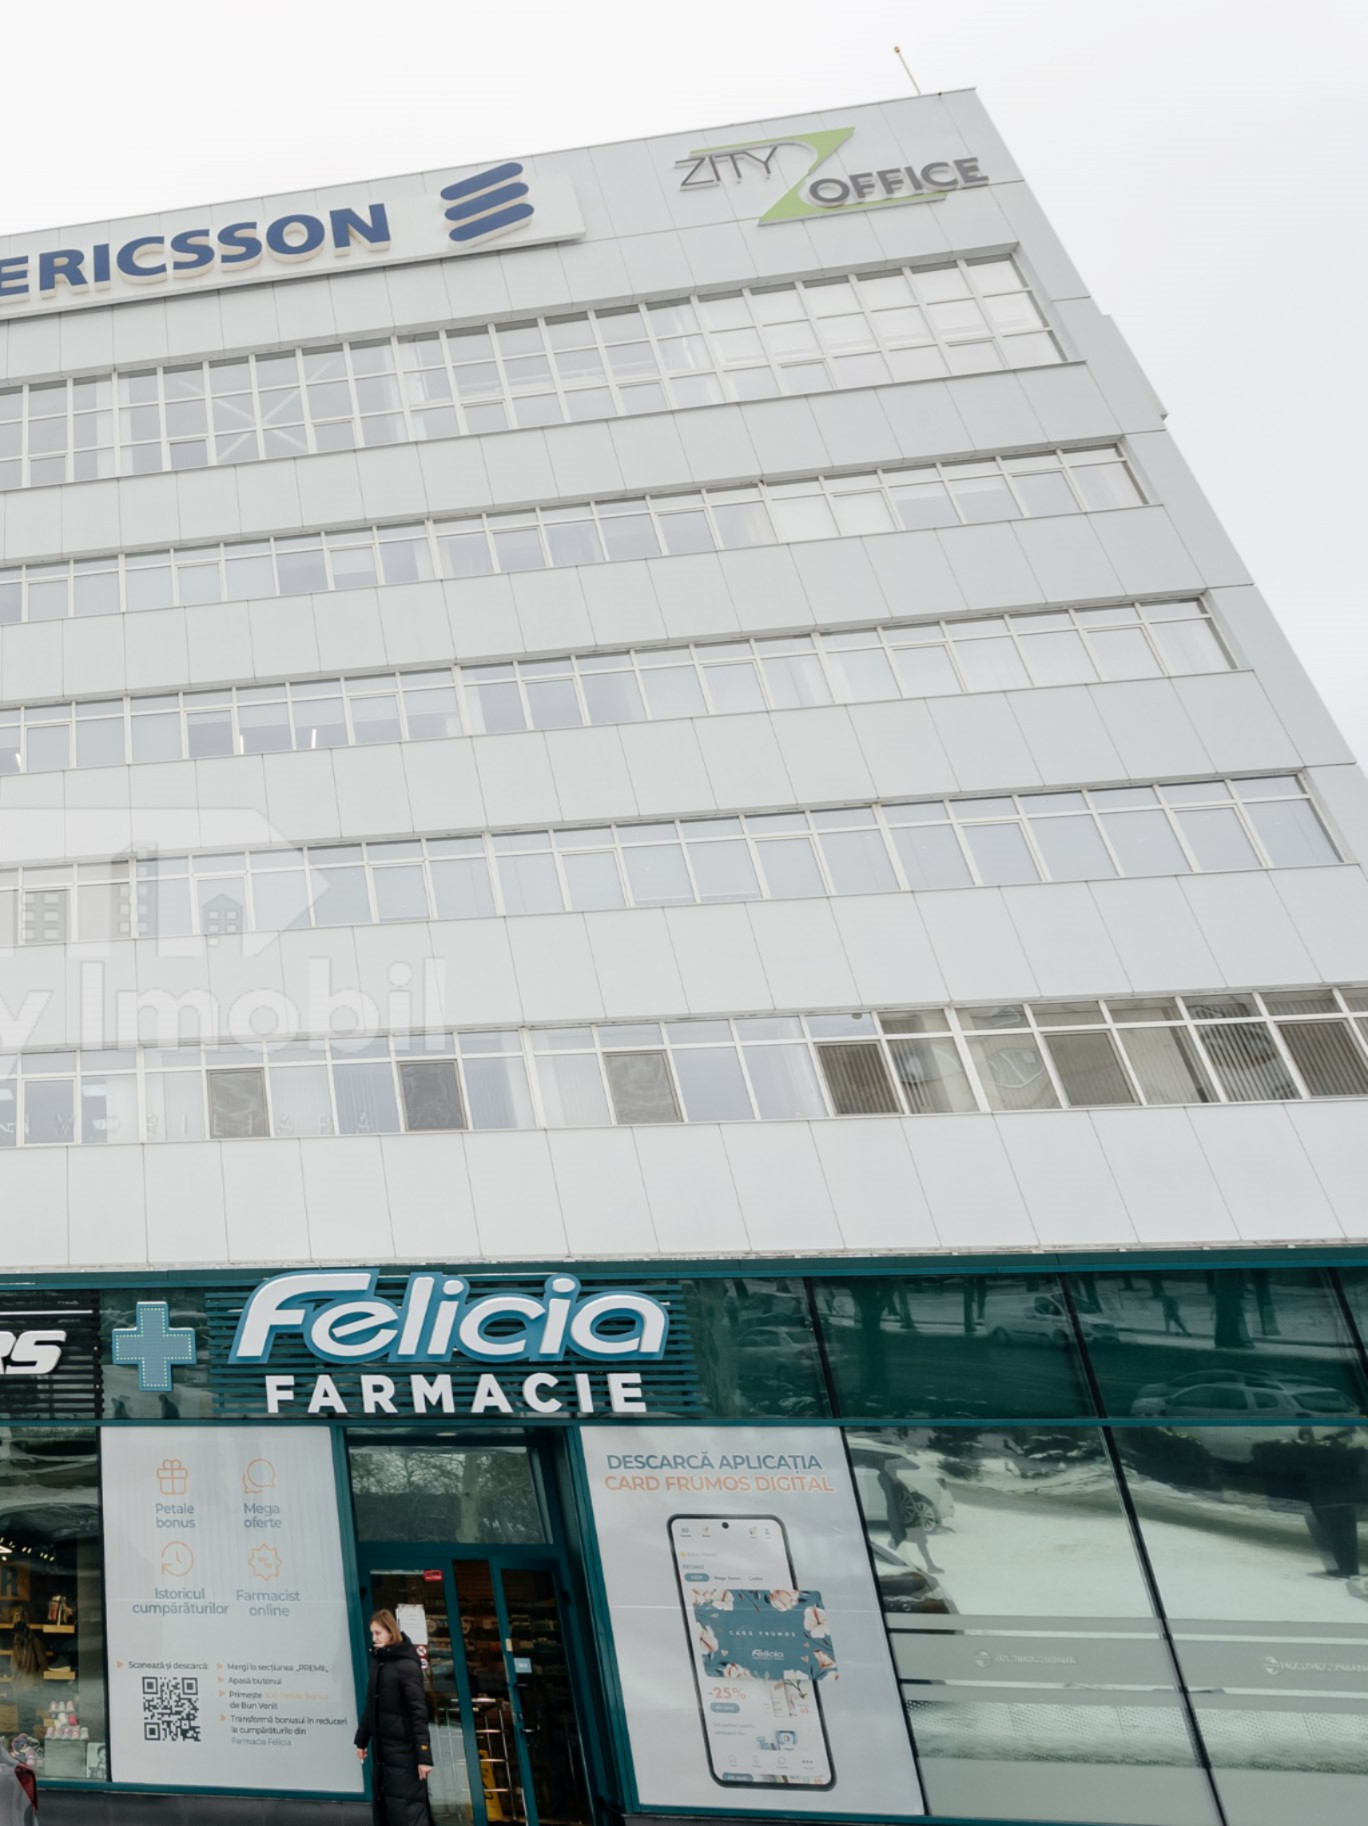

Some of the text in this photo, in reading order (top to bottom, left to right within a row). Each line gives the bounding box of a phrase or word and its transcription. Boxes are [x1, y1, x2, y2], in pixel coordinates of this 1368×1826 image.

[674, 145, 778, 189] ZITY
[809, 156, 989, 205] OFFICE
[234, 1270, 669, 1361] Felicia
[264, 1372, 649, 1415] FARMACIE
[606, 1451, 715, 1470] DESCARCĂ
[604, 1475, 836, 1492] CARD FRUMOS DIGITAL
[155, 1503, 195, 1515] Petale
[243, 1503, 280, 1517] Mega
[155, 1517, 196, 1529] bonus
[243, 1517, 282, 1529] oferte
[154, 1587, 206, 1600] Istoricul
[235, 1589, 301, 1602] Farmacist
[132, 1602, 230, 1617] cumpărăturilor
[248, 1604, 291, 1617] online
[751, 1648, 785, 1659] Felicia
[227, 1663, 249, 1673] Mergi
[708, 1686, 747, 1700] -25%
[230, 1701, 240, 1709] de
[241, 1702, 257, 1710] Bun
[315, 1717, 348, 1726] reduceri
[293, 1727, 307, 1736] din
